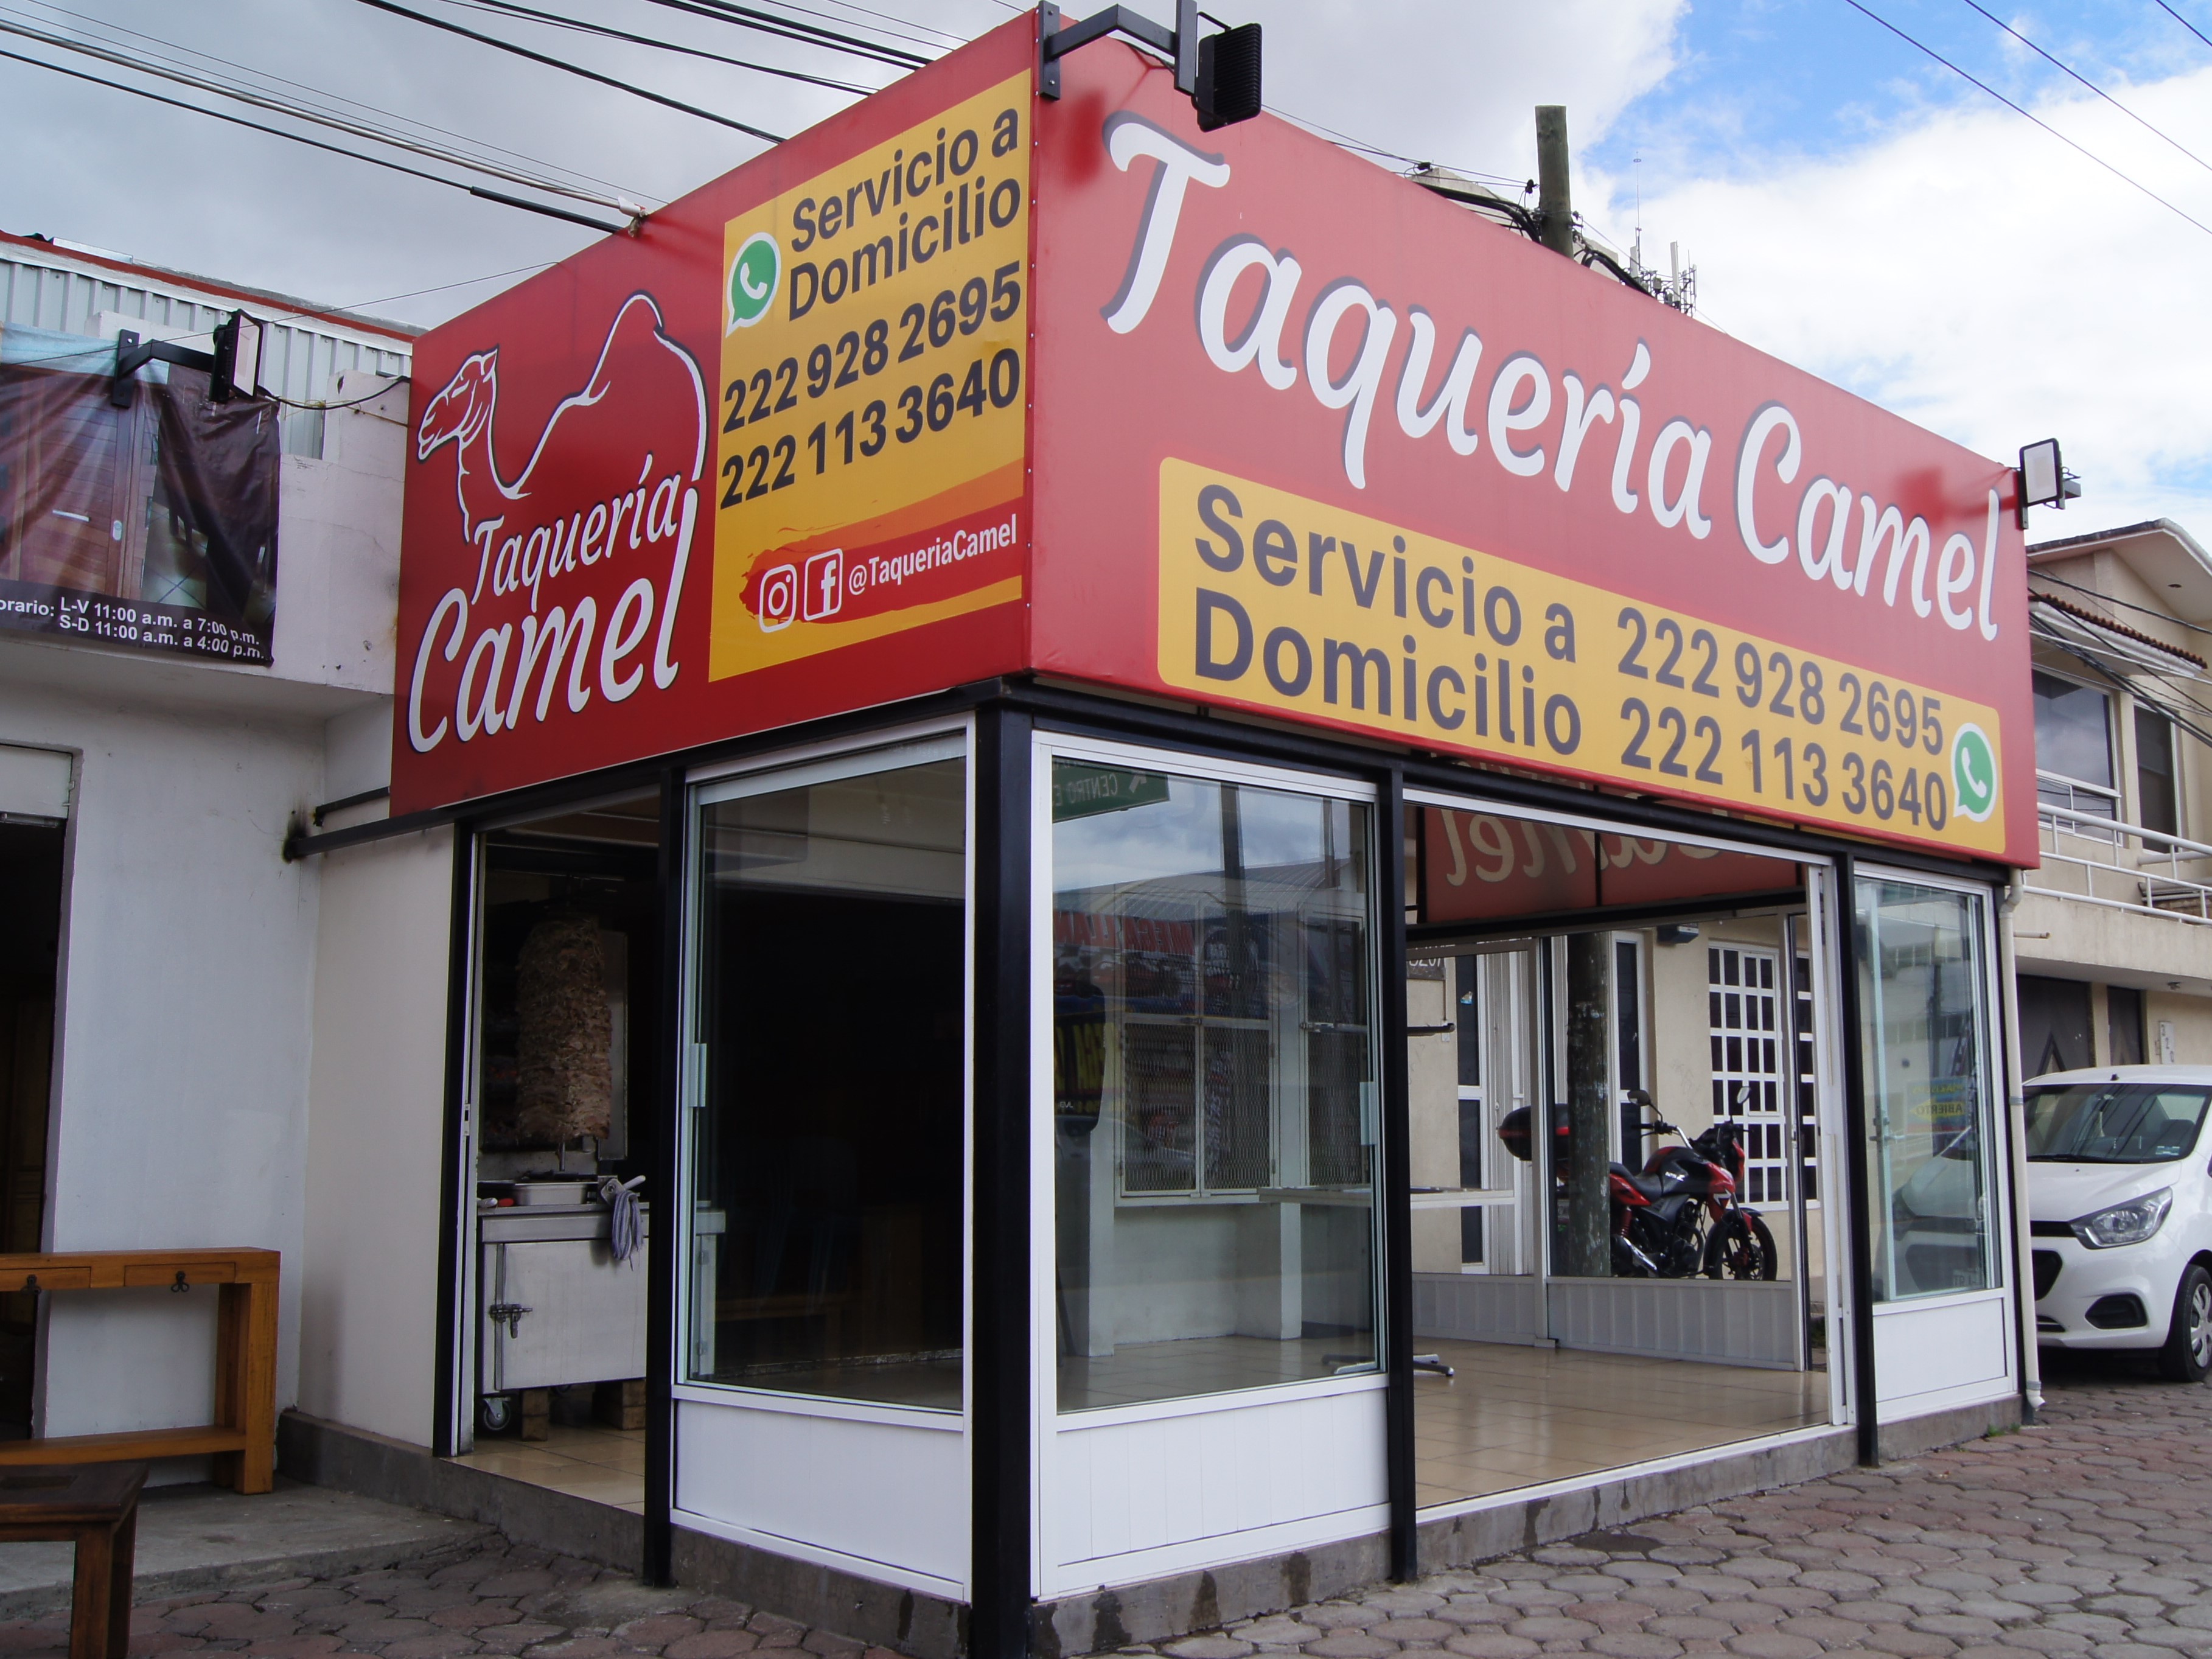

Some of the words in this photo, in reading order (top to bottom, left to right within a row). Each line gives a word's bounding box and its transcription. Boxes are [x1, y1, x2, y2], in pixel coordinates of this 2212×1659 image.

[789, 175, 1021, 322] Domicilio
[790, 126, 979, 253] Servicio
[991, 108, 1019, 158] a
[722, 357, 799, 435] 222
[806, 318, 889, 399] 928
[898, 260, 1021, 363] 2695
[1103, 116, 1712, 540] Taquería
[1734, 402, 2000, 641] Camel
[720, 435, 796, 511] 222
[807, 399, 887, 475] 113
[895, 348, 1020, 444] 3640
[472, 453, 682, 613] Taquería
[848, 513, 1017, 596] @TaqueriaCamel
[1195, 483, 1522, 647] Servicio
[1544, 602, 1577, 663] a
[60, 614, 89, 632] S-D
[95, 620, 138, 640] 11:00
[142, 631, 178, 646] a.m.
[183, 636, 193, 648] a
[197, 634, 229, 654] 4:00
[232, 644, 265, 660] p.m.
[61, 596, 89, 615] L-V
[94, 602, 137, 623] 11:00
[142, 613, 178, 628] a.m.
[183, 619, 193, 630] a
[198, 617, 228, 637] 7:00
[230, 628, 260, 645] p.m.
[408, 487, 699, 753] Camel
[1195, 586, 1582, 756] Domicilio
[1616, 606, 1720, 699] 222
[1734, 641, 1826, 725] 928
[1838, 672, 1943, 756] 2695
[1619, 697, 1724, 786] 222
[1740, 728, 1829, 808] 113
[1841, 752, 1947, 832] 3640
